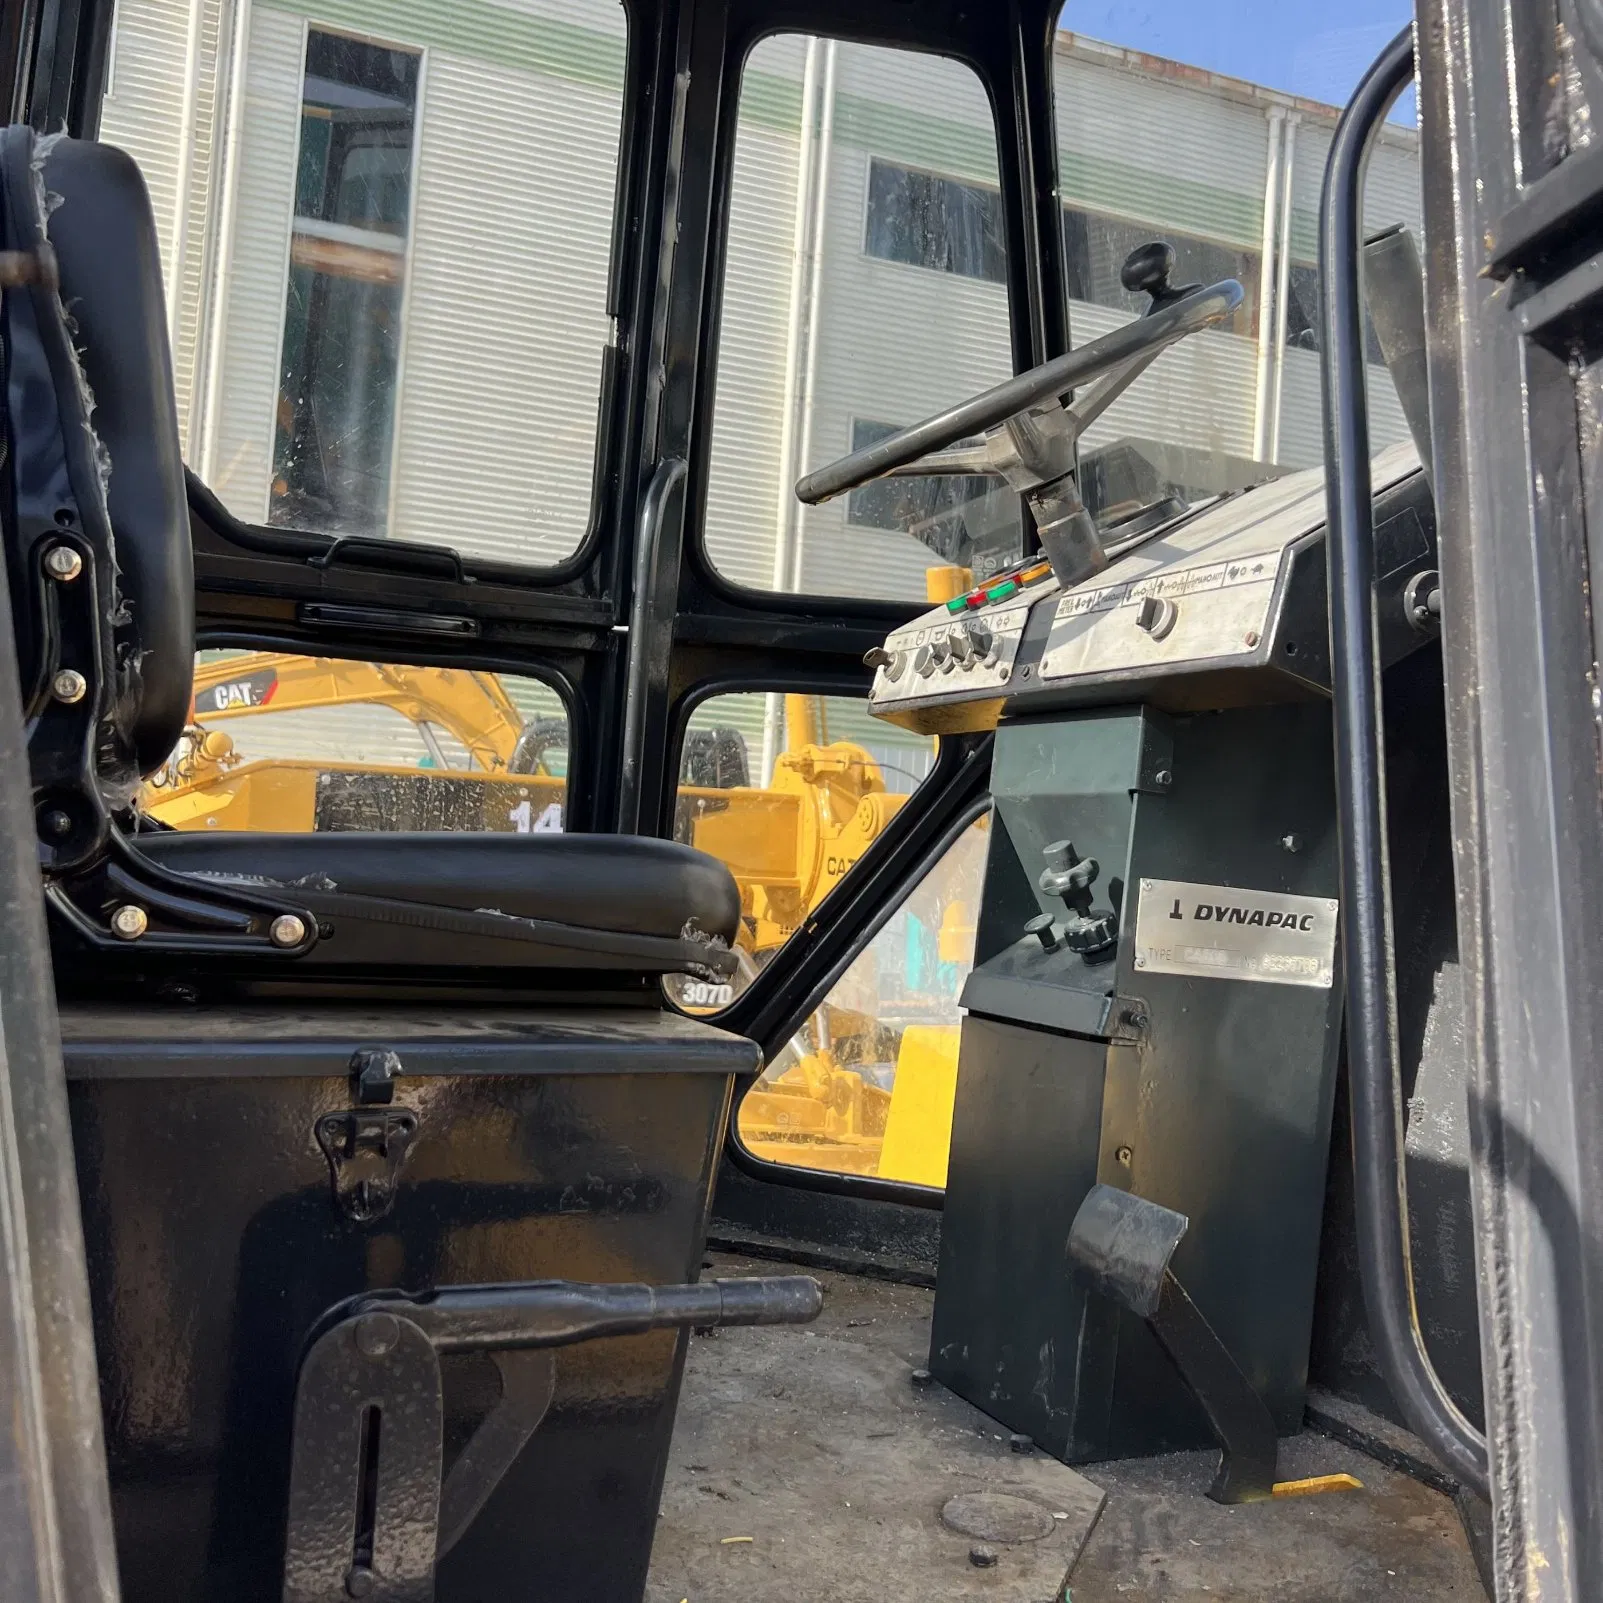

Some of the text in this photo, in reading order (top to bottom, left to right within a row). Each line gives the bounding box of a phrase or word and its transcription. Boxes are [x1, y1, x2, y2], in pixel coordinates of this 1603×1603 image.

[214, 682, 252, 710] CAT
[1193, 903, 1315, 932] DYNAPAC
[1147, 947, 1172, 961] TYPE
